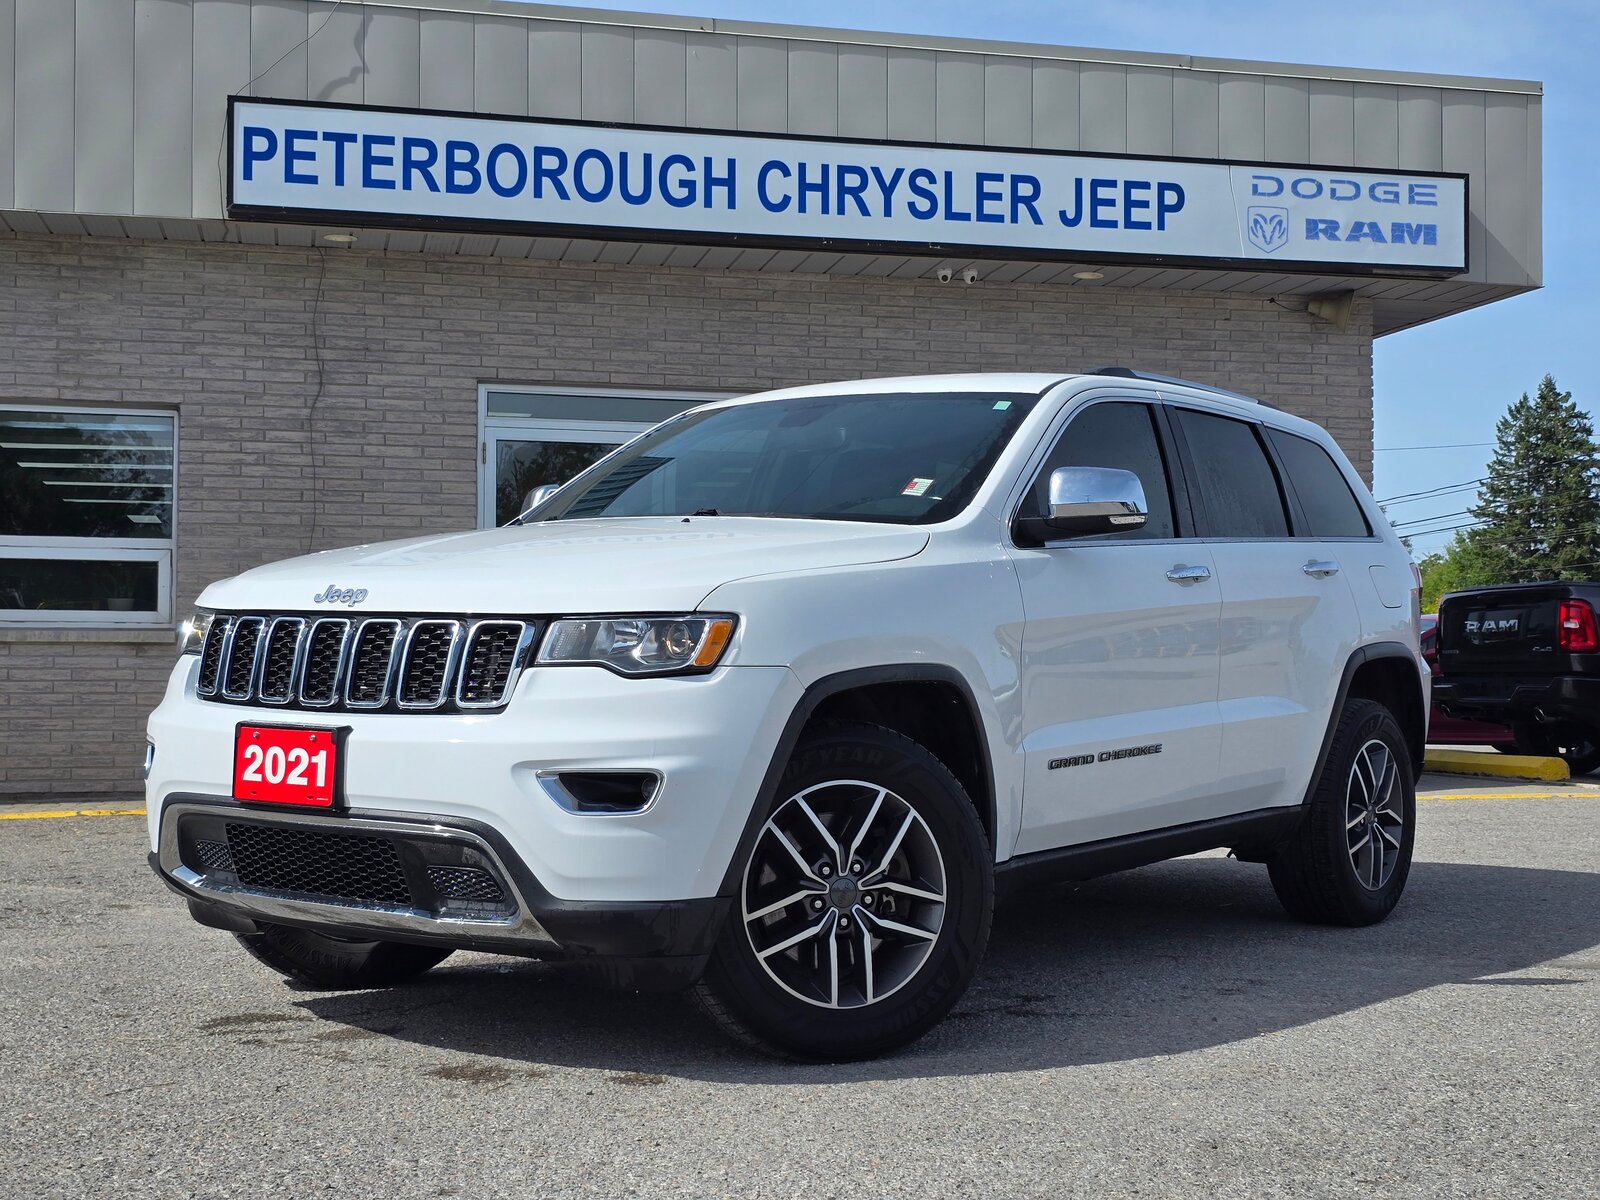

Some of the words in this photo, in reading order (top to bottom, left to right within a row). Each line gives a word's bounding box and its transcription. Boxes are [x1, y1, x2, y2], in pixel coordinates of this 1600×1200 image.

[242, 126, 737, 210] PETERBOROUGH
[757, 159, 1044, 226] CHRYSLER
[1058, 177, 1186, 231] JEEP
[1251, 174, 1438, 206] DODGE
[1305, 218, 1438, 246] RAM
[313, 584, 369, 607] Jeep
[1464, 619, 1519, 633] RAM
[242, 744, 327, 788] 2021
[1047, 754, 1095, 770] GRAND
[1097, 743, 1163, 762] CHEROKEE
